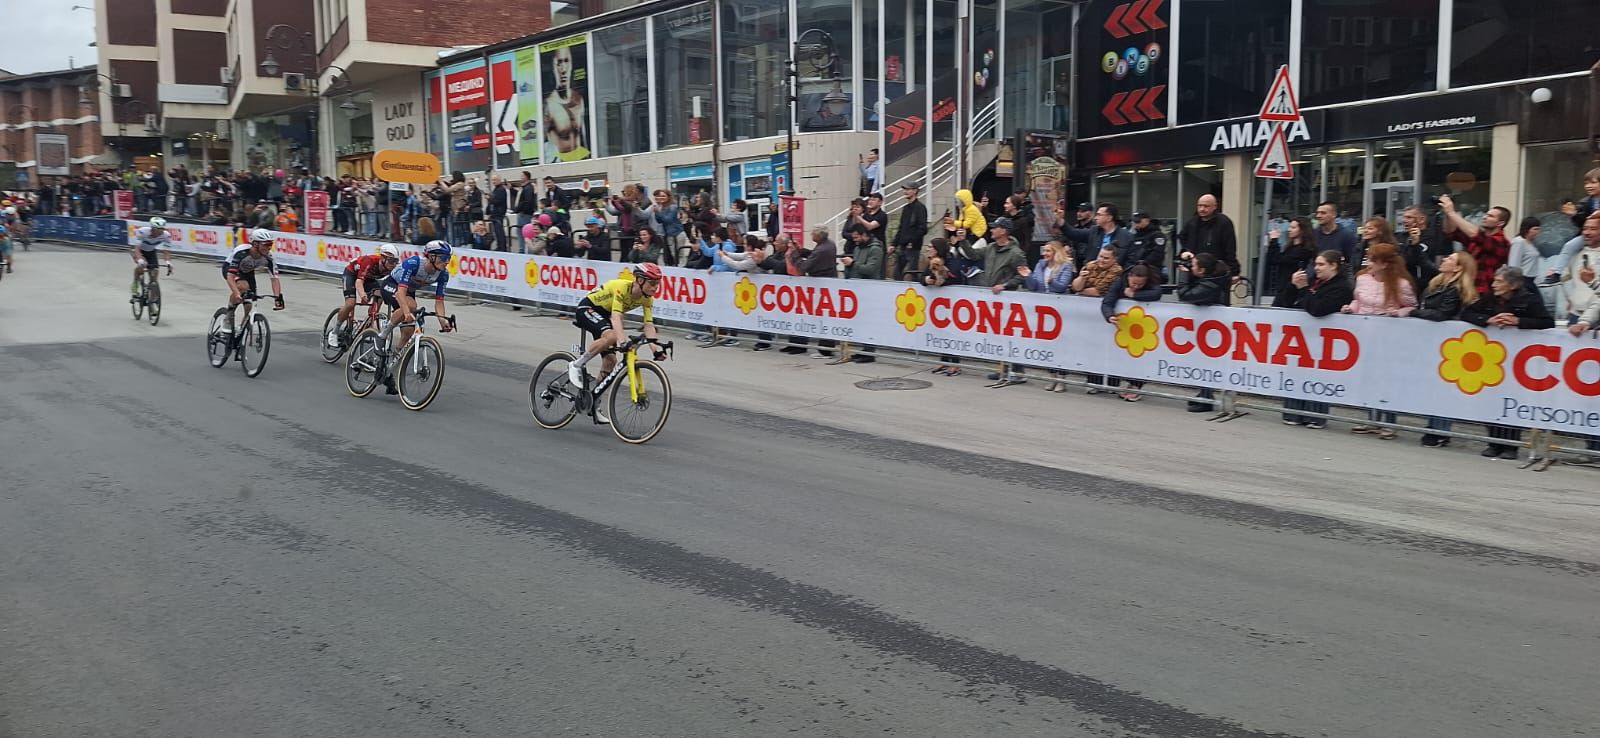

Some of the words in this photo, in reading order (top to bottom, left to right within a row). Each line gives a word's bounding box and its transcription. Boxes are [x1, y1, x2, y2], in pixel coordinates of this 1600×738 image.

[384, 102, 413, 121] LADY
[1425, 116, 1476, 128] FASHION
[386, 123, 415, 141] GOLD
[276, 237, 306, 256] CONAD
[459, 255, 508, 281] CONAD
[540, 264, 598, 292] CONAD
[760, 283, 859, 320] CONAD
[757, 315, 792, 332] Persone
[794, 319, 817, 334] oltre
[820, 320, 829, 335] le
[831, 326, 854, 338] cose
[929, 297, 1063, 341] CONAD
[926, 333, 971, 352] Persone
[975, 338, 1003, 356] oltre
[1008, 341, 1020, 358] le
[1024, 348, 1054, 361] cose
[1163, 317, 1361, 372] CONAD
[1157, 359, 1223, 383] Persone
[1229, 367, 1271, 389] oltre
[1279, 371, 1295, 392] le
[1302, 380, 1345, 398] cose
[1502, 397, 1600, 428] Persone
